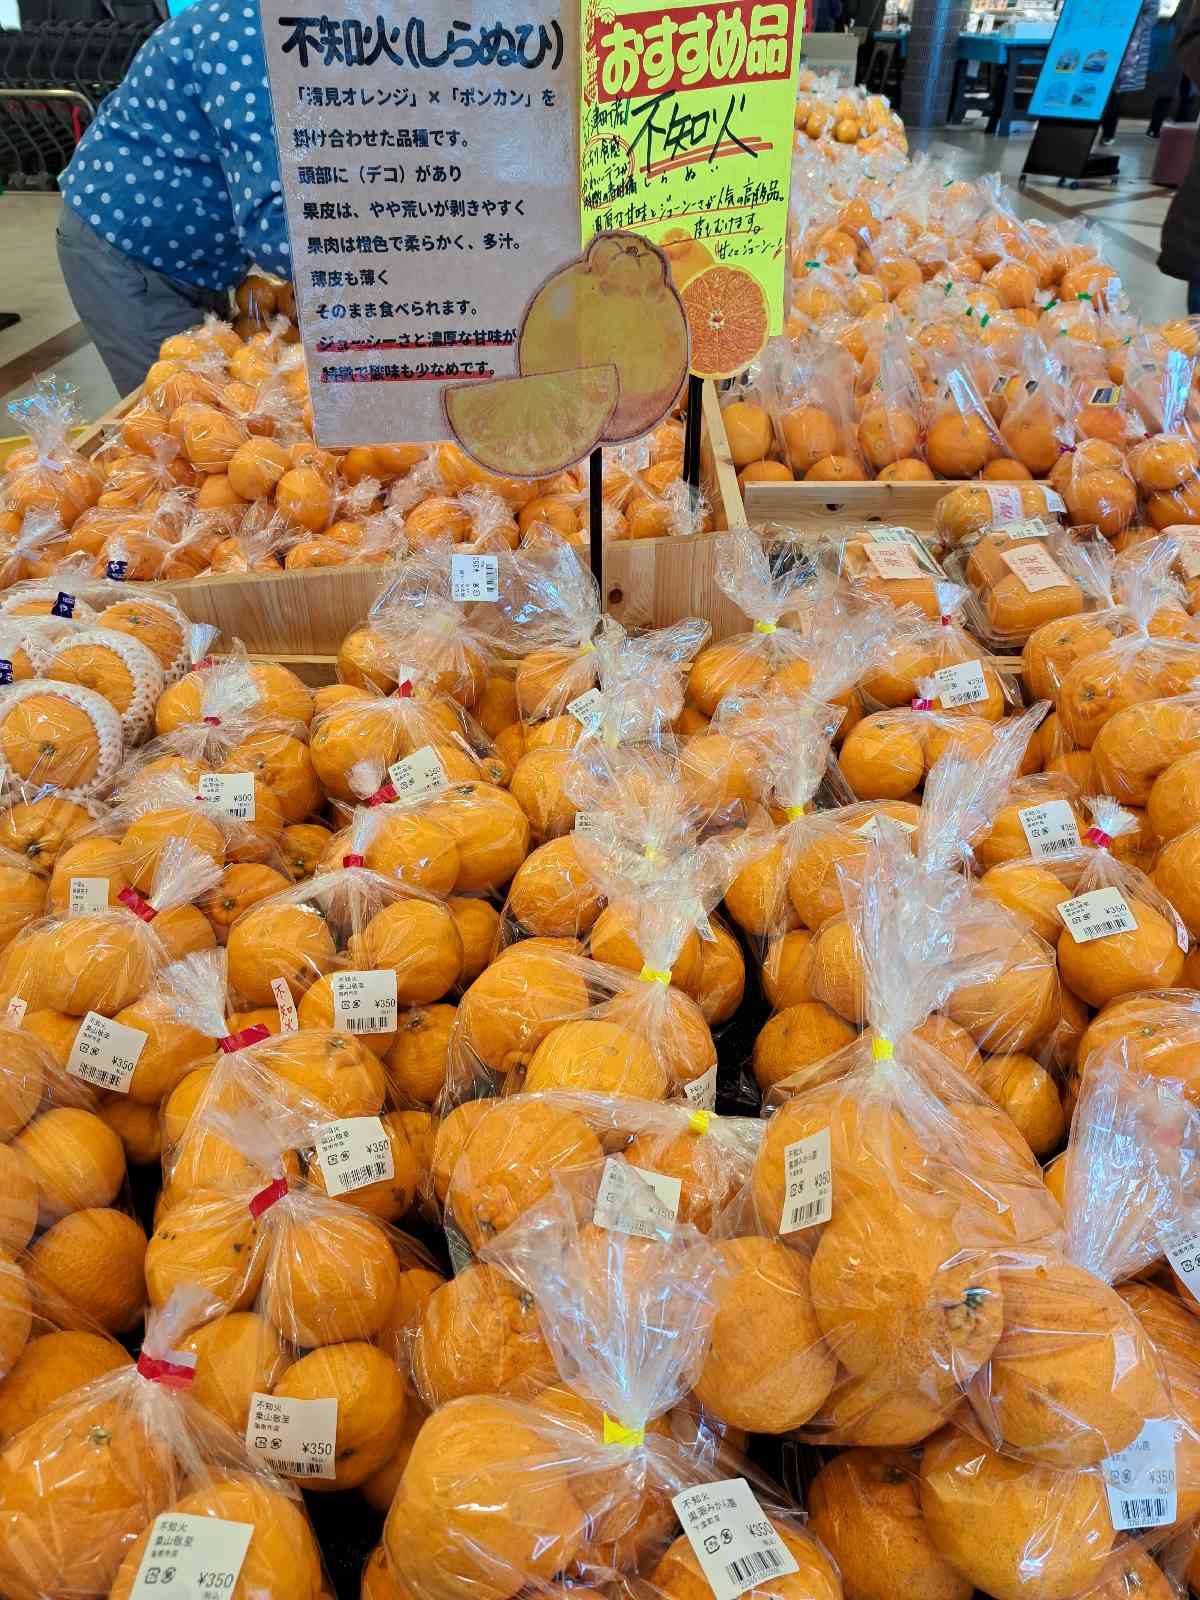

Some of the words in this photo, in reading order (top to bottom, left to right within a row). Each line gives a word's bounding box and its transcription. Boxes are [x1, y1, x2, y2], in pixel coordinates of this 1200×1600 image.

[278, 15, 564, 70] 不知火(しらぬひ)
[601, 4, 790, 95] おすすめ品
[293, 129, 470, 148] 掛け合わせた品種です。
[631, 89, 759, 178] 不知火
[298, 165, 462, 184] 頭部に(デコ)があり
[303, 200, 525, 220] 果皮は、やや荒いが剥きやすく
[307, 232, 521, 255] 果肉は橙色で柔らかく、多汁。
[311, 270, 389, 288] 薄皮も薄く
[316, 300, 478, 320] そのまま食べられます。
[375, 998, 396, 1008] ¥350
[112, 1056, 134, 1072] ¥350
[366, 1139, 389, 1153] ¥350
[302, 1441, 332, 1455] ¥350
[197, 1570, 235, 1589] ¥350
